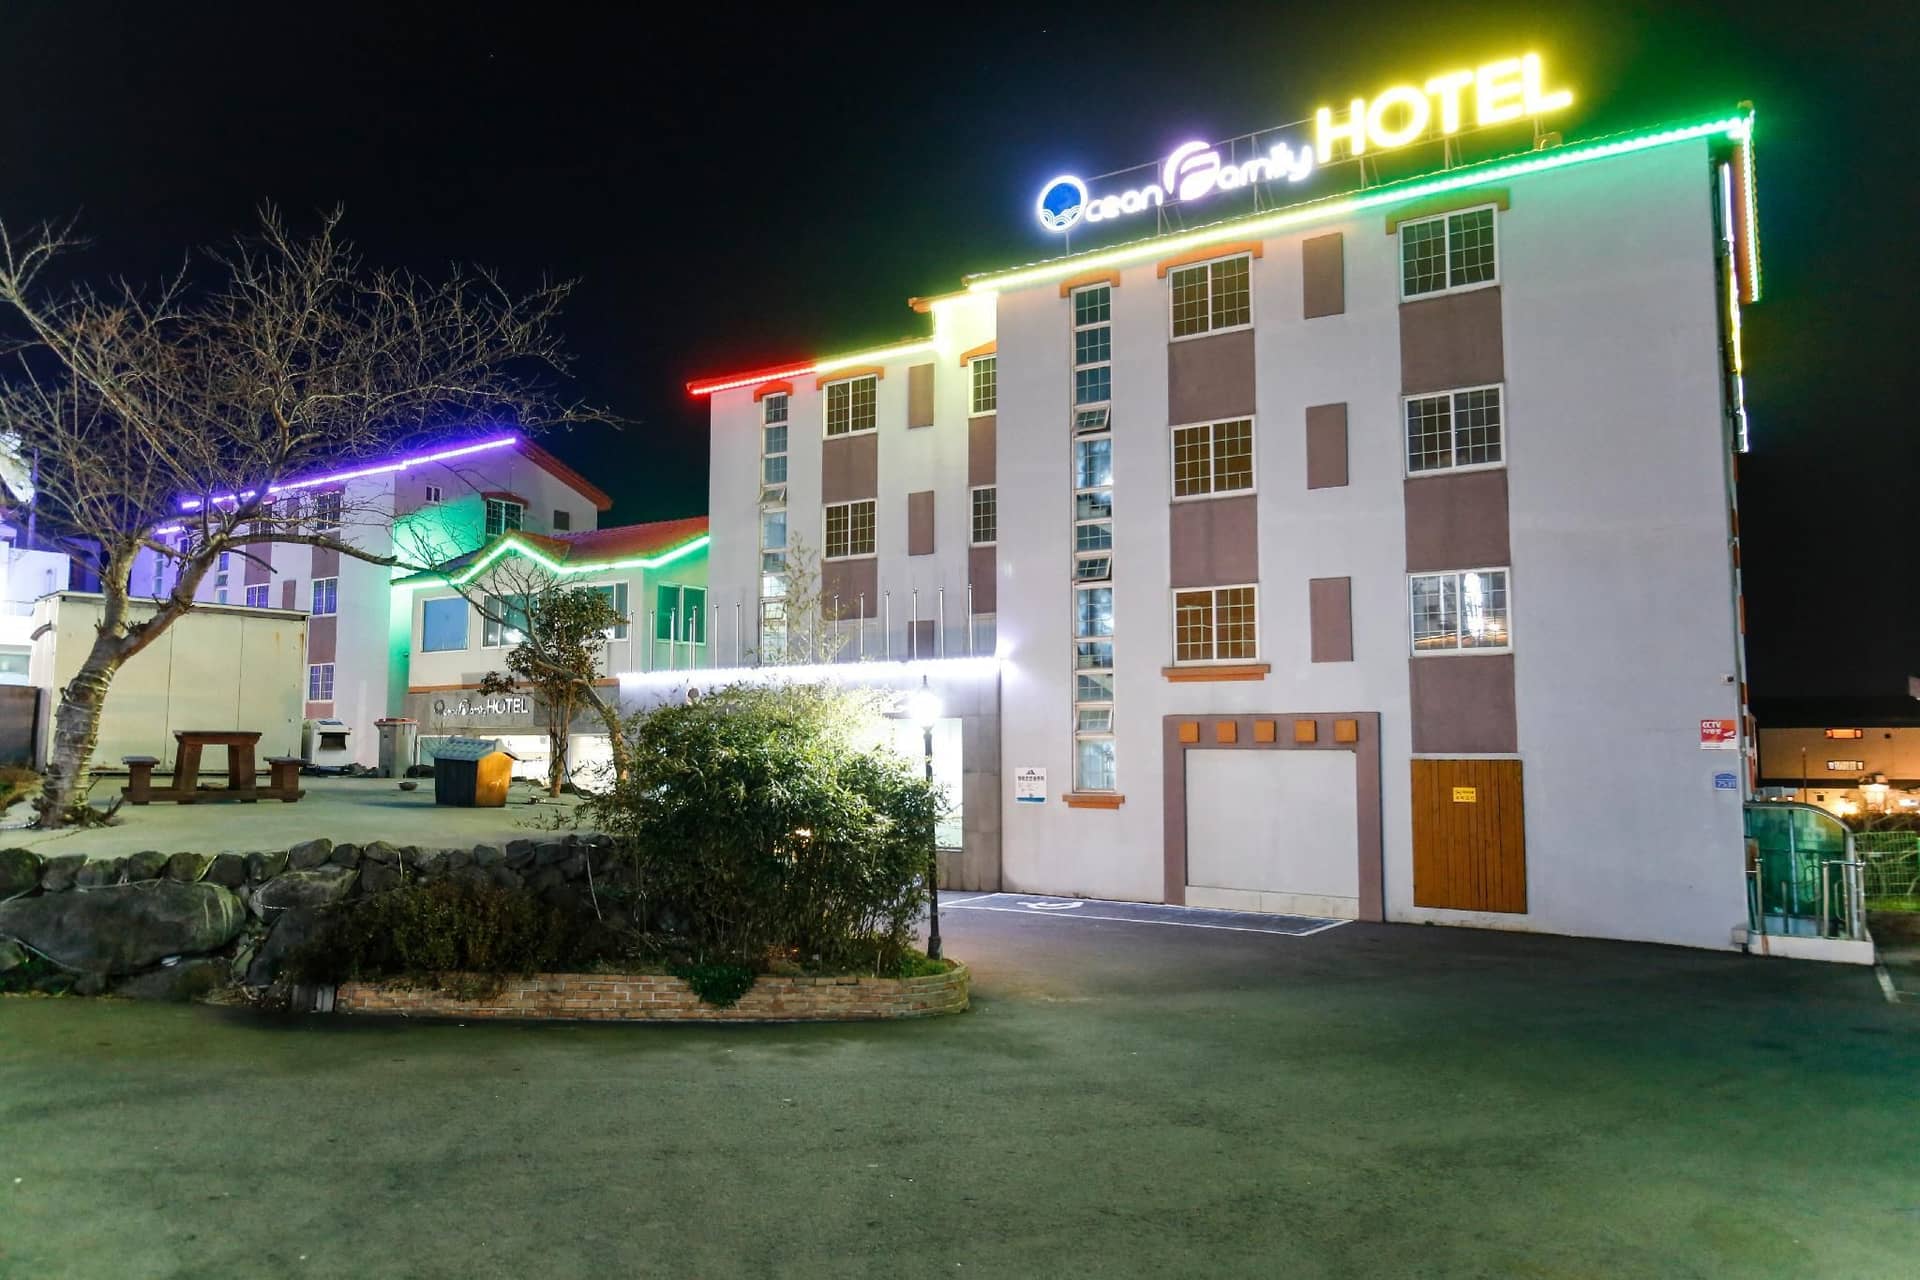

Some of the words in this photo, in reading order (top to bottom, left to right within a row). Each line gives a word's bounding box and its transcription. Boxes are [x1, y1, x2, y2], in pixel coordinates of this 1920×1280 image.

[1038, 175, 1163, 232] Ocean
[1162, 141, 1314, 201] Family
[1315, 53, 1574, 165] HOTEL
[487, 696, 529, 714] HOTEL
[1702, 721, 1721, 729] CCTV
